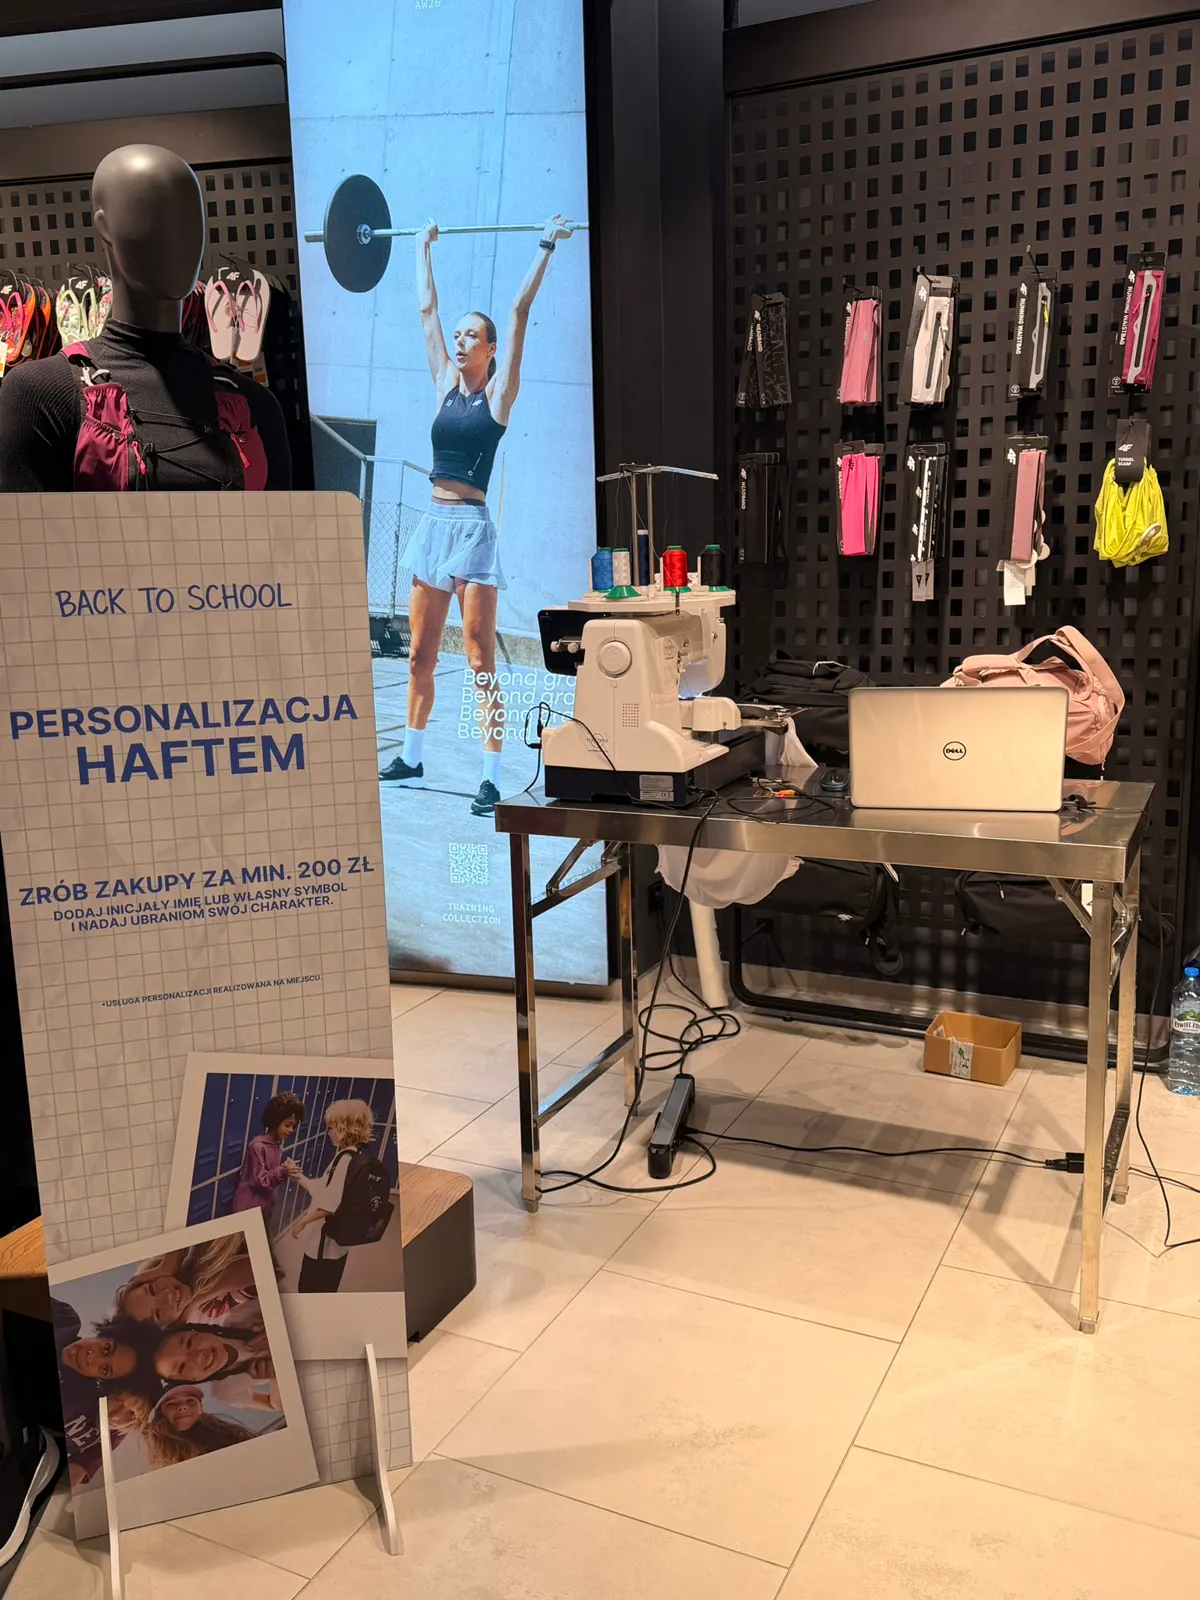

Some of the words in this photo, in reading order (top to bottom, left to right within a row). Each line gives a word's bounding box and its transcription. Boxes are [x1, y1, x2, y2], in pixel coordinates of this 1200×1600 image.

[75, 280, 88, 290] 4F
[226, 271, 241, 281] 4F
[0, 284, 13, 295] 4F
[918, 285, 927, 302] 4F
[1020, 282, 1028, 296] 4F
[1018, 298, 1026, 327] RUNNING
[1015, 327, 1024, 355] WAISTBAG
[1006, 448, 1016, 465] 4F
[1118, 443, 1133, 452] 4F
[907, 455, 916, 471] 4F
[55, 587, 127, 617] BACK
[138, 587, 175, 614] TO
[187, 583, 293, 610] SCHOOL
[463, 668, 537, 690] Beyond
[461, 687, 536, 708] Beyond
[9, 693, 359, 740] PERSONALIZACJA
[460, 705, 533, 726] Beyond
[457, 723, 532, 744] Beyond
[76, 732, 306, 785] HAFTEM
[18, 879, 89, 907] ZRÓB
[94, 872, 196, 899] ZAKUPY
[202, 869, 236, 889] ZA
[241, 863, 292, 884] MIN.
[297, 858, 341, 879] 200
[347, 856, 375, 874] ZŁ
[53, 907, 103, 922] DODAJ
[106, 899, 170, 916] INICJAŁY
[173, 895, 201, 909] IMIĘ
[204, 893, 231, 906] LUB
[233, 887, 291, 903] WŁASNY
[294, 882, 348, 897] SYMBOL
[448, 902, 495, 913] TRAINING
[71, 921, 75, 932] I
[78, 916, 127, 932] NADAJ
[131, 906, 205, 926] UBRANIOM
[208, 902, 248, 918] SWÓJ
[251, 896, 334, 913] CHARAKTER.
[442, 913, 501, 925] COLLECTION
[142, 988, 212, 1003] PERSONALIZACJI
[213, 980, 272, 995] REALIZOWANA
[273, 978, 285, 987] NA
[286, 974, 323, 985] MIEJSCU.
